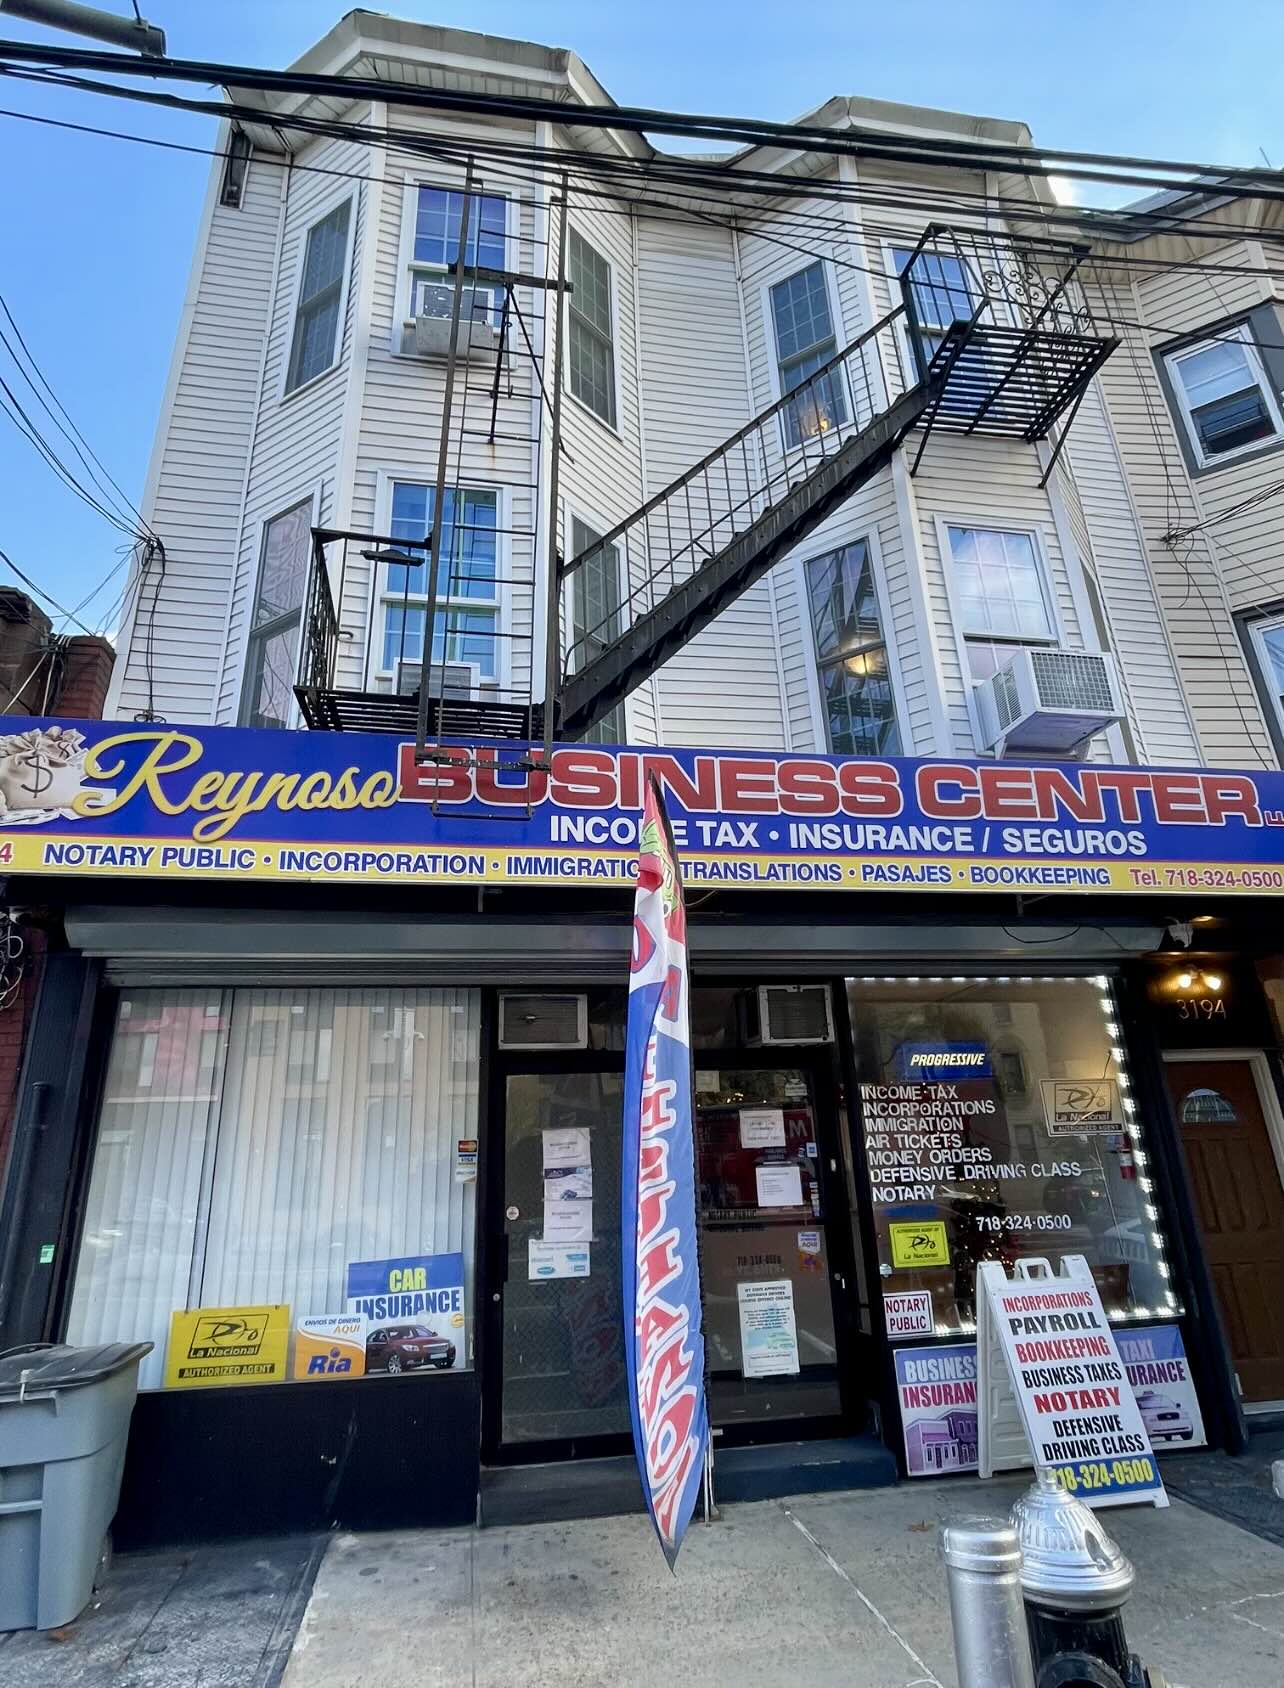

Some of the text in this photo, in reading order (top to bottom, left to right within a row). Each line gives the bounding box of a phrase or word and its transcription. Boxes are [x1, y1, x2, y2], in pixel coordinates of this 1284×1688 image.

[72, 731, 403, 842] Reynoso
[398, 743, 903, 818] BUSINESS
[916, 764, 1263, 827] CENTER
[550, 815, 689, 846] INCOE
[695, 820, 760, 848] TAX
[789, 822, 975, 852] INSURANCE
[1003, 828, 1147, 855] SEGUROS
[44, 843, 1110, 887] NOTARY PUBLIC INCORPORATION IMMIGRATIO TRANSLATIONS PASAJES BOOKKEEPING
[1129, 868, 1284, 889] Tel. 718-324-0500
[1176, 999, 1227, 1020] 3194
[910, 1053, 985, 1067] PROGRESSIVE
[861, 1085, 958, 1100] INCOME TAX
[863, 1100, 996, 1117] INCORPORATIONS
[865, 1117, 963, 1132] IMMIGRATION
[865, 1133, 962, 1149] AIR TICKETS
[869, 1148, 992, 1166] MONEY ORDERS
[870, 1162, 1082, 1183] DEFENSIVE DRIVING CLASS
[873, 1185, 935, 1202] NOTARY
[389, 1267, 427, 1293] CAR
[355, 1289, 460, 1321] INSURANCE
[885, 1297, 926, 1314] NOTARY
[1002, 1291, 1093, 1313] INCORPORATIONS
[333, 1325, 360, 1334] AQUI
[890, 1315, 926, 1331] PUBLIC
[1008, 1311, 1101, 1336] PAYROLL
[189, 1346, 258, 1358] La Nacional
[307, 1347, 352, 1375] Ria
[1015, 1336, 1111, 1364] BOOKKEEPING
[183, 1364, 272, 1378] AUTHORIZED AGENT
[904, 1355, 977, 1383] BUSINES
[1022, 1362, 1122, 1389] BUSINESS TAXES
[1125, 1361, 1187, 1387] URANCE
[902, 1381, 977, 1408] INSURAN
[1033, 1387, 1121, 1414] NOTARY
[1052, 1415, 1123, 1438] DEFENSIVE
[1042, 1433, 1145, 1461] DRIVING CLASS
[1055, 1458, 1154, 1490] 18-324-0500
